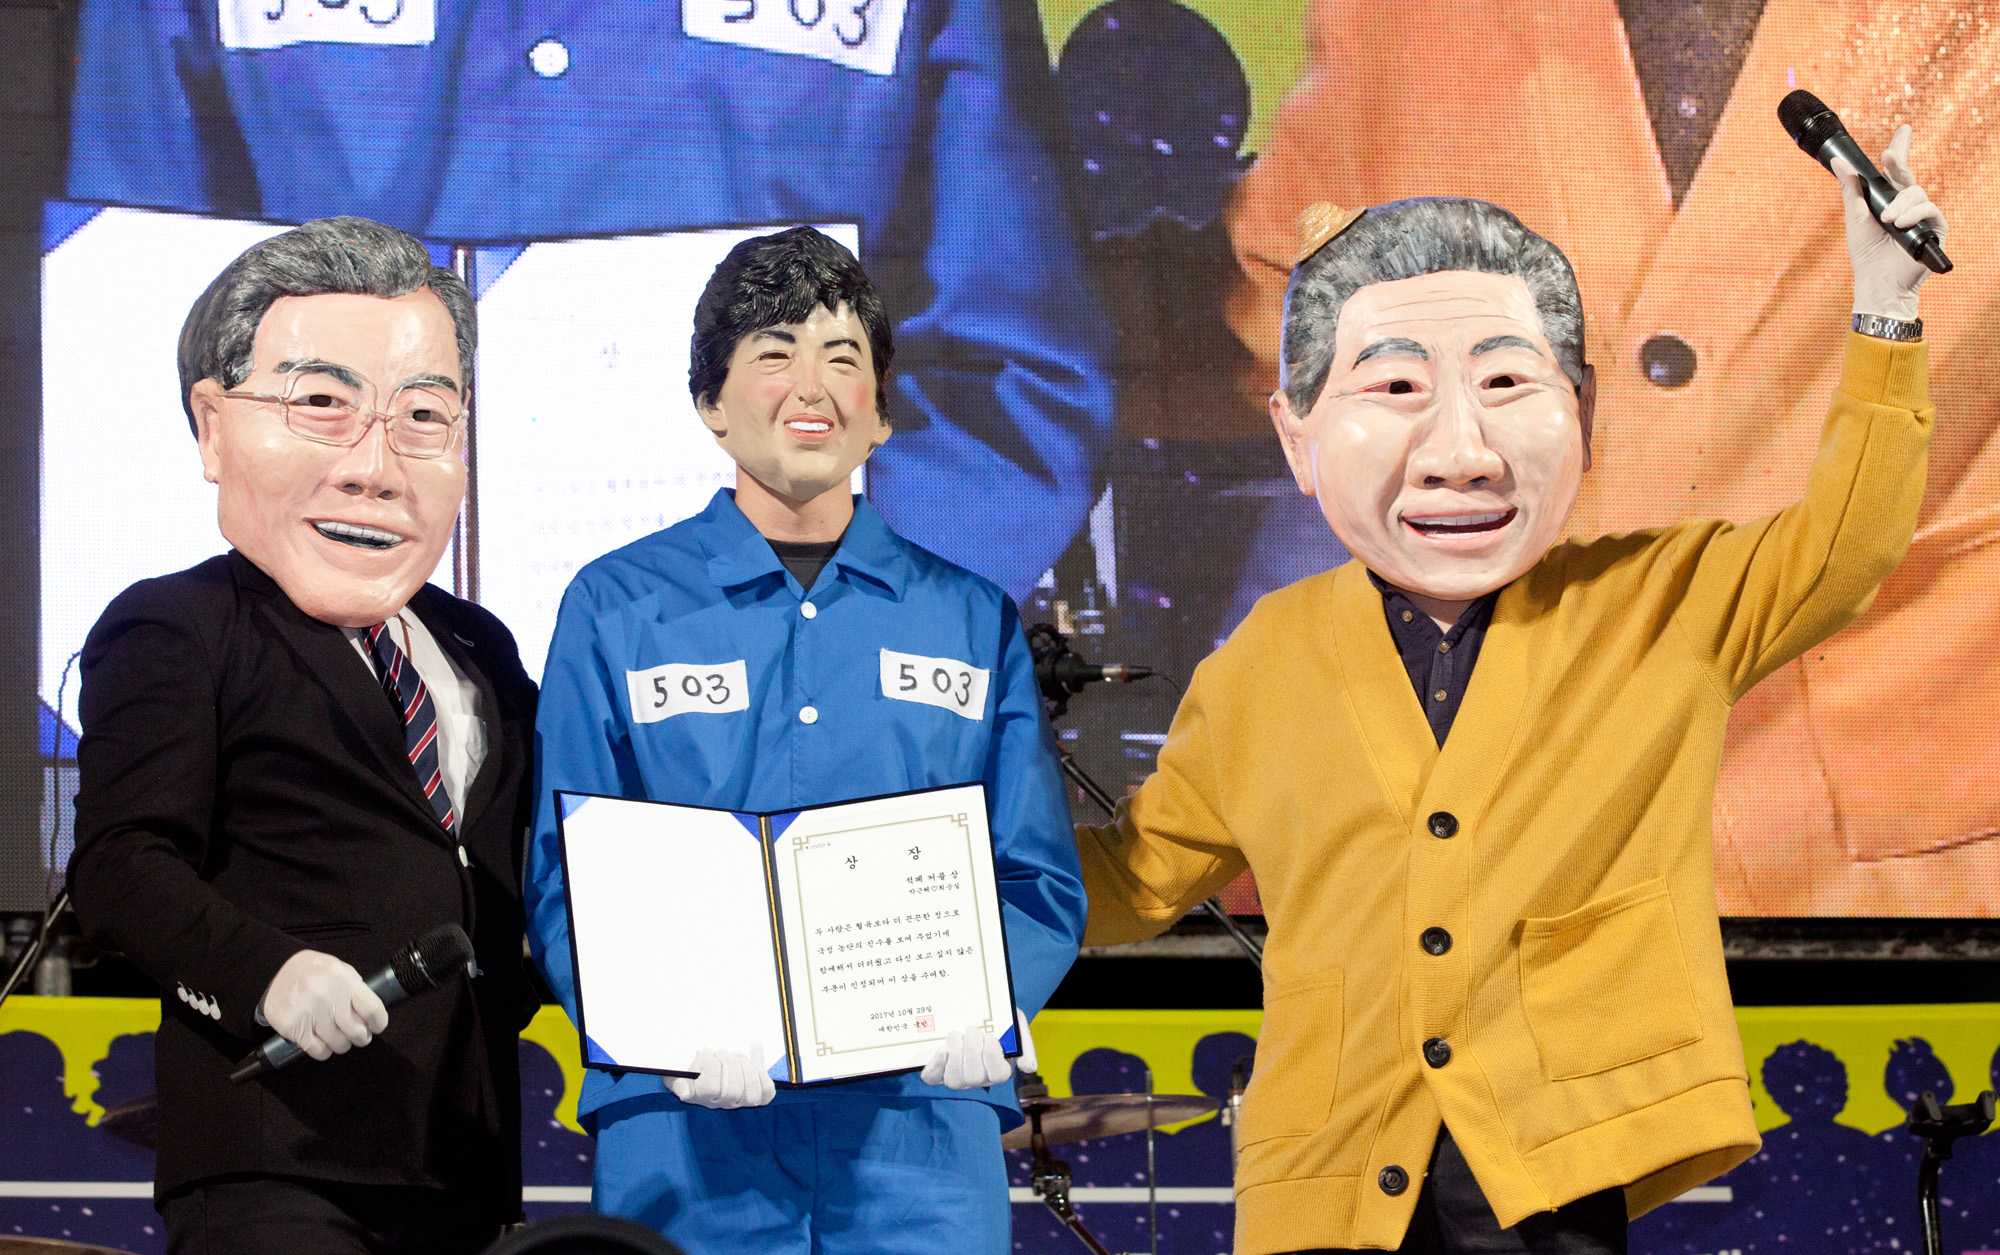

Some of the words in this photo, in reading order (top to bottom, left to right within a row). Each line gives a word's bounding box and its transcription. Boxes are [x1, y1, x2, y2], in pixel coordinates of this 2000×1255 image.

[653, 674, 730, 708] 503
[899, 663, 971, 706] 503
[844, 855, 858, 869] 상
[908, 846, 921, 860] 장
[951, 870, 958, 879] 상
[827, 924, 852, 934] 사람은
[893, 916, 900, 924] 더
[935, 910, 960, 919] 정으로
[817, 946, 832, 955] 국정
[838, 942, 862, 952] 농단의
[867, 937, 892, 948] 진수를
[896, 934, 911, 943] 보여
[916, 929, 949, 941] 주었기에
[820, 962, 852, 974] 함께해서
[857, 958, 892, 968] 더러웠고
[895, 954, 911, 963] 다신
[916, 952, 933, 960] 보고
[936, 949, 952, 958] 싶지
[957, 947, 973, 955] 않은
[822, 983, 846, 993] 부분이
[901, 973, 917, 982] 상을
[921, 969, 949, 979] 수여함.
[870, 1011, 894, 1020] 2017년
[898, 1008, 913, 1016] 10월
[916, 1005, 931, 1013] 29일
[879, 1023, 908, 1032] 대한민국
